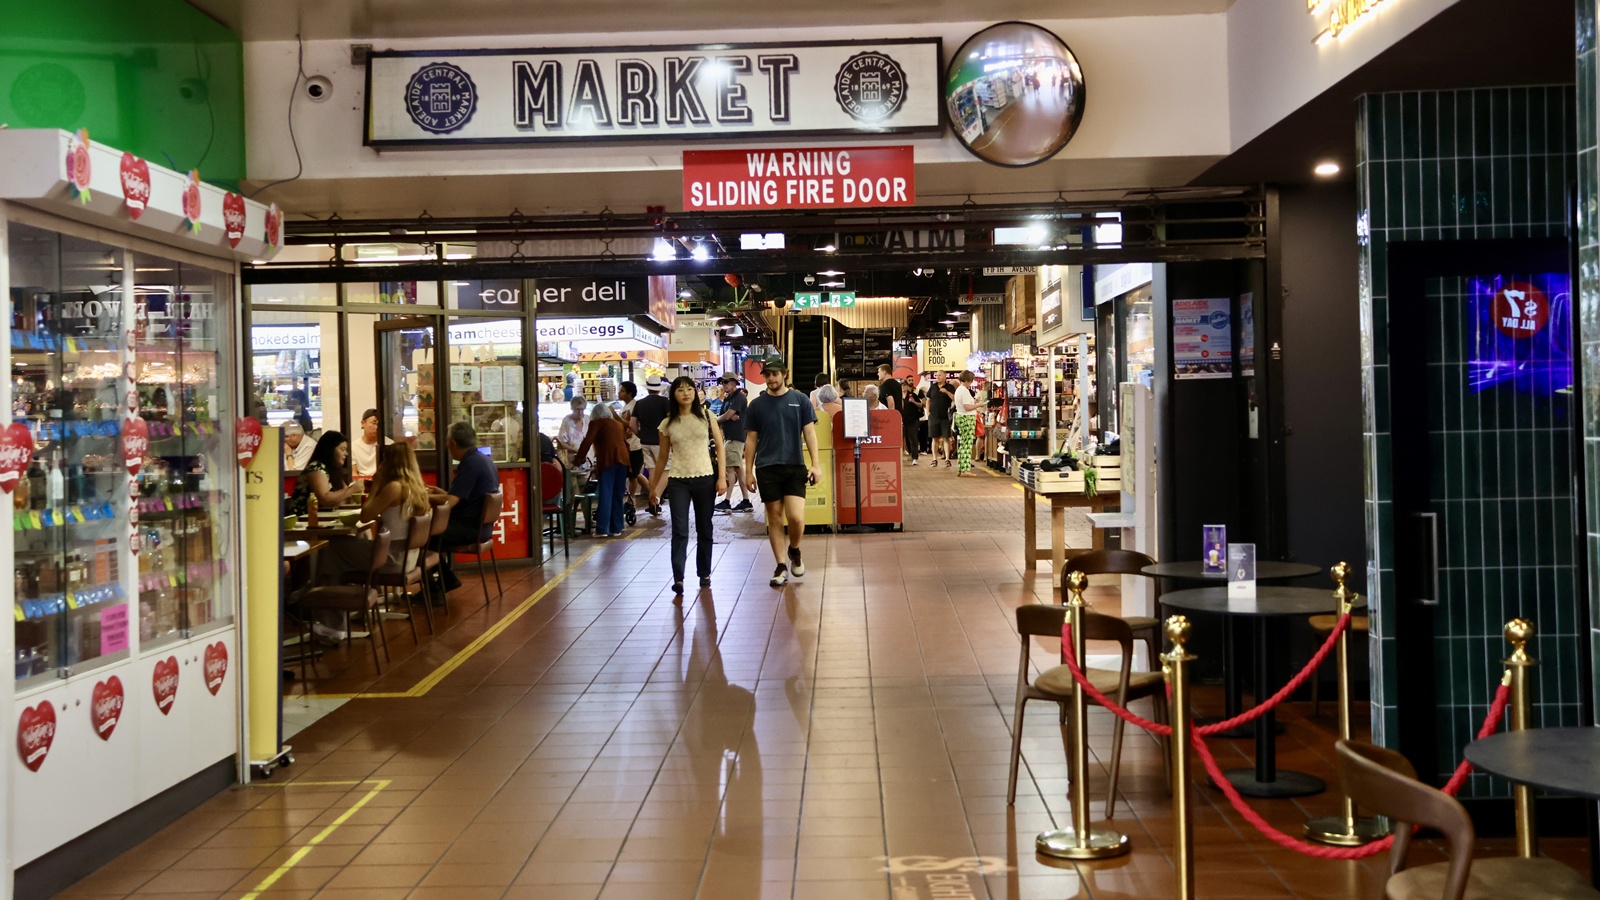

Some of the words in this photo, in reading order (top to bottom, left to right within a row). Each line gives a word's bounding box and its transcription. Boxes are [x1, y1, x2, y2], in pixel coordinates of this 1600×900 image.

[422, 68, 465, 89] CENTRAL
[852, 57, 896, 78] CENTRAL
[410, 81, 438, 126] ADELAIDE
[513, 54, 798, 131] MARKET
[841, 70, 869, 115] ADELAIDE
[445, 91, 471, 127] MARKET
[747, 151, 851, 177] WARNING
[691, 179, 778, 207] SLIDING
[786, 178, 834, 204] FIRE
[843, 177, 907, 203] DOOR
[582, 281, 626, 301] deli
[928, 348, 943, 356] FINE
[928, 356, 946, 365] FOOD
[855, 436, 882, 444] ASTE
